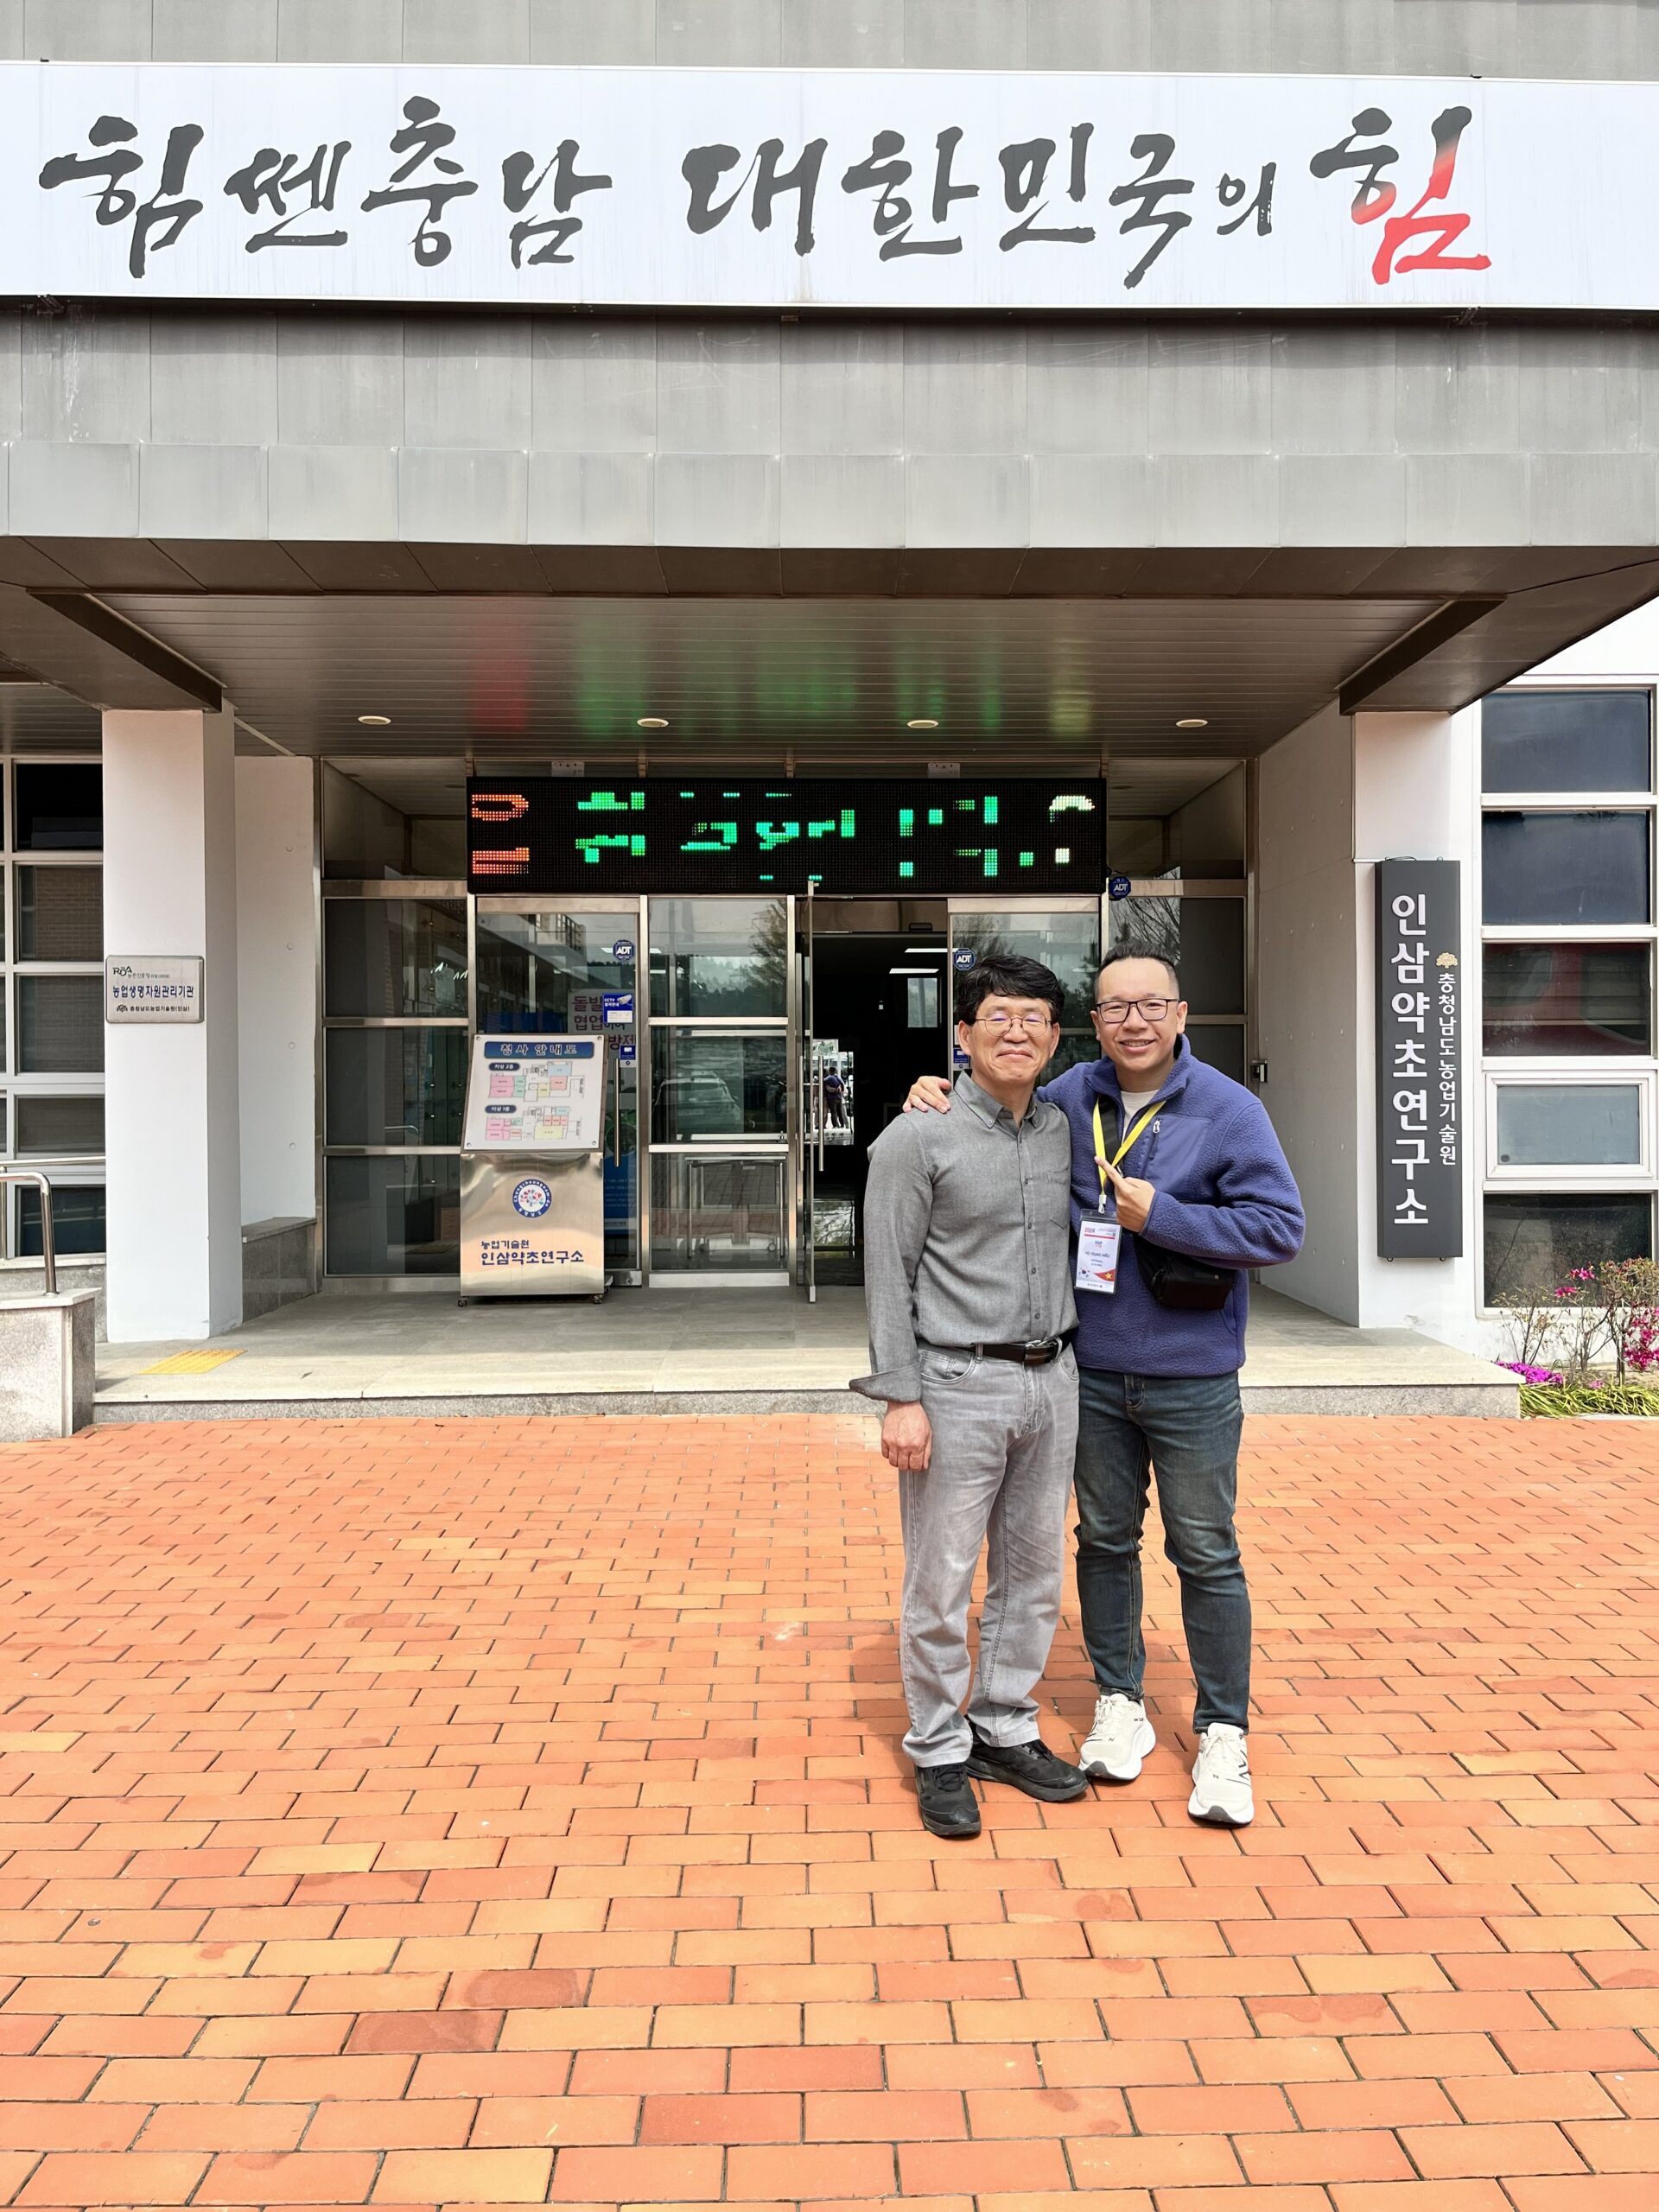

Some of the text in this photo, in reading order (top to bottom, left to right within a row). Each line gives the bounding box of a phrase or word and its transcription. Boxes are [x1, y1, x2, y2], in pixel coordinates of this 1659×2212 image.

[682, 123, 1276, 289] 대한민국의
[1310, 106, 1491, 284] 힘
[1114, 883, 1128, 892] ADT
[616, 946, 632, 955] ADT
[957, 955, 971, 963] ADT
[112, 966, 132, 976] RDA
[113, 985, 194, 998] 농업생명자원관리기관
[500, 1043, 577, 1056] 청사 안내도
[1392, 894, 1429, 1224] 인삼약초연구소
[1439, 973, 1457, 1165] 충청남도농업기술원
[481, 1239, 530, 1249] 농업기술원
[481, 1250, 585, 1265] 인삼약초연구소
